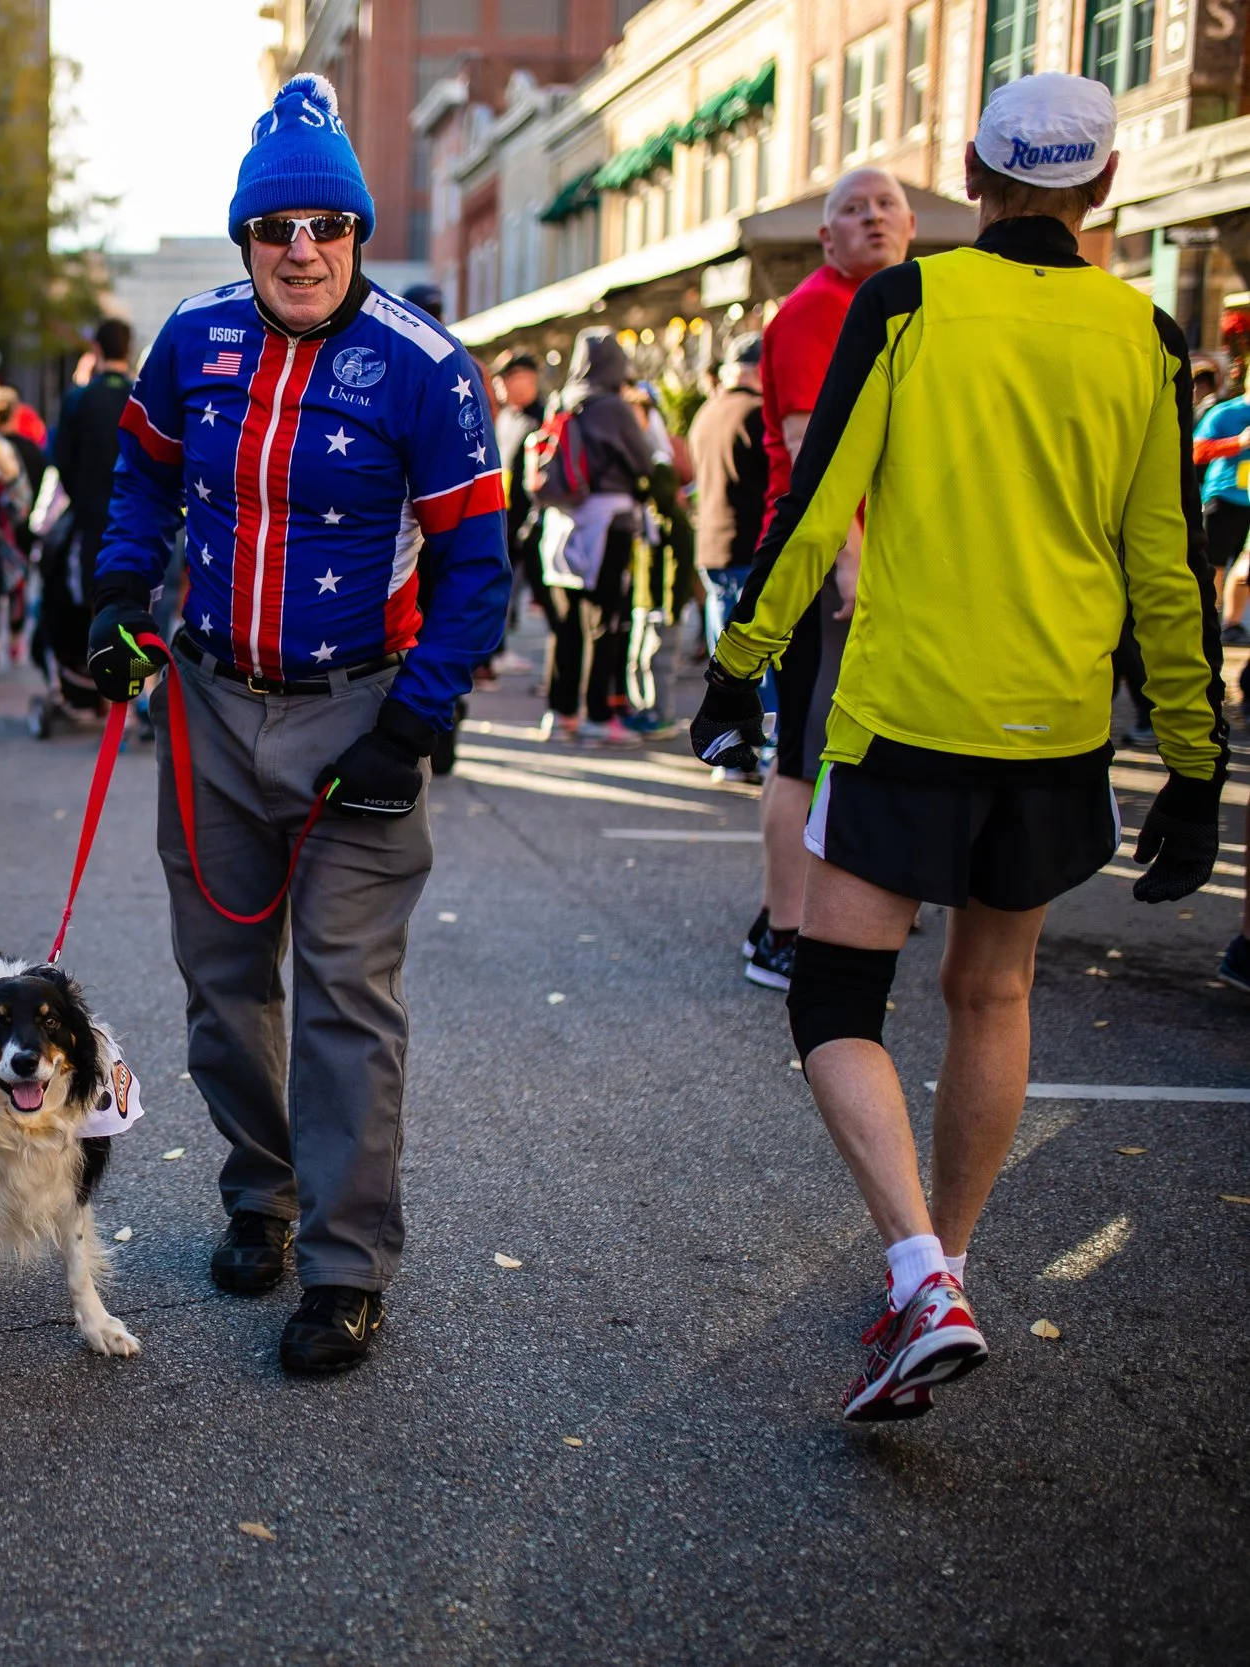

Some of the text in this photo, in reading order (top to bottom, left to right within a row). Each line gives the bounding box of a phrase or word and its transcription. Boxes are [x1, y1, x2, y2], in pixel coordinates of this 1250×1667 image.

[1003, 136, 1097, 170] RONZONI
[375, 298, 421, 328] VOLER
[209, 326, 247, 343] USDST
